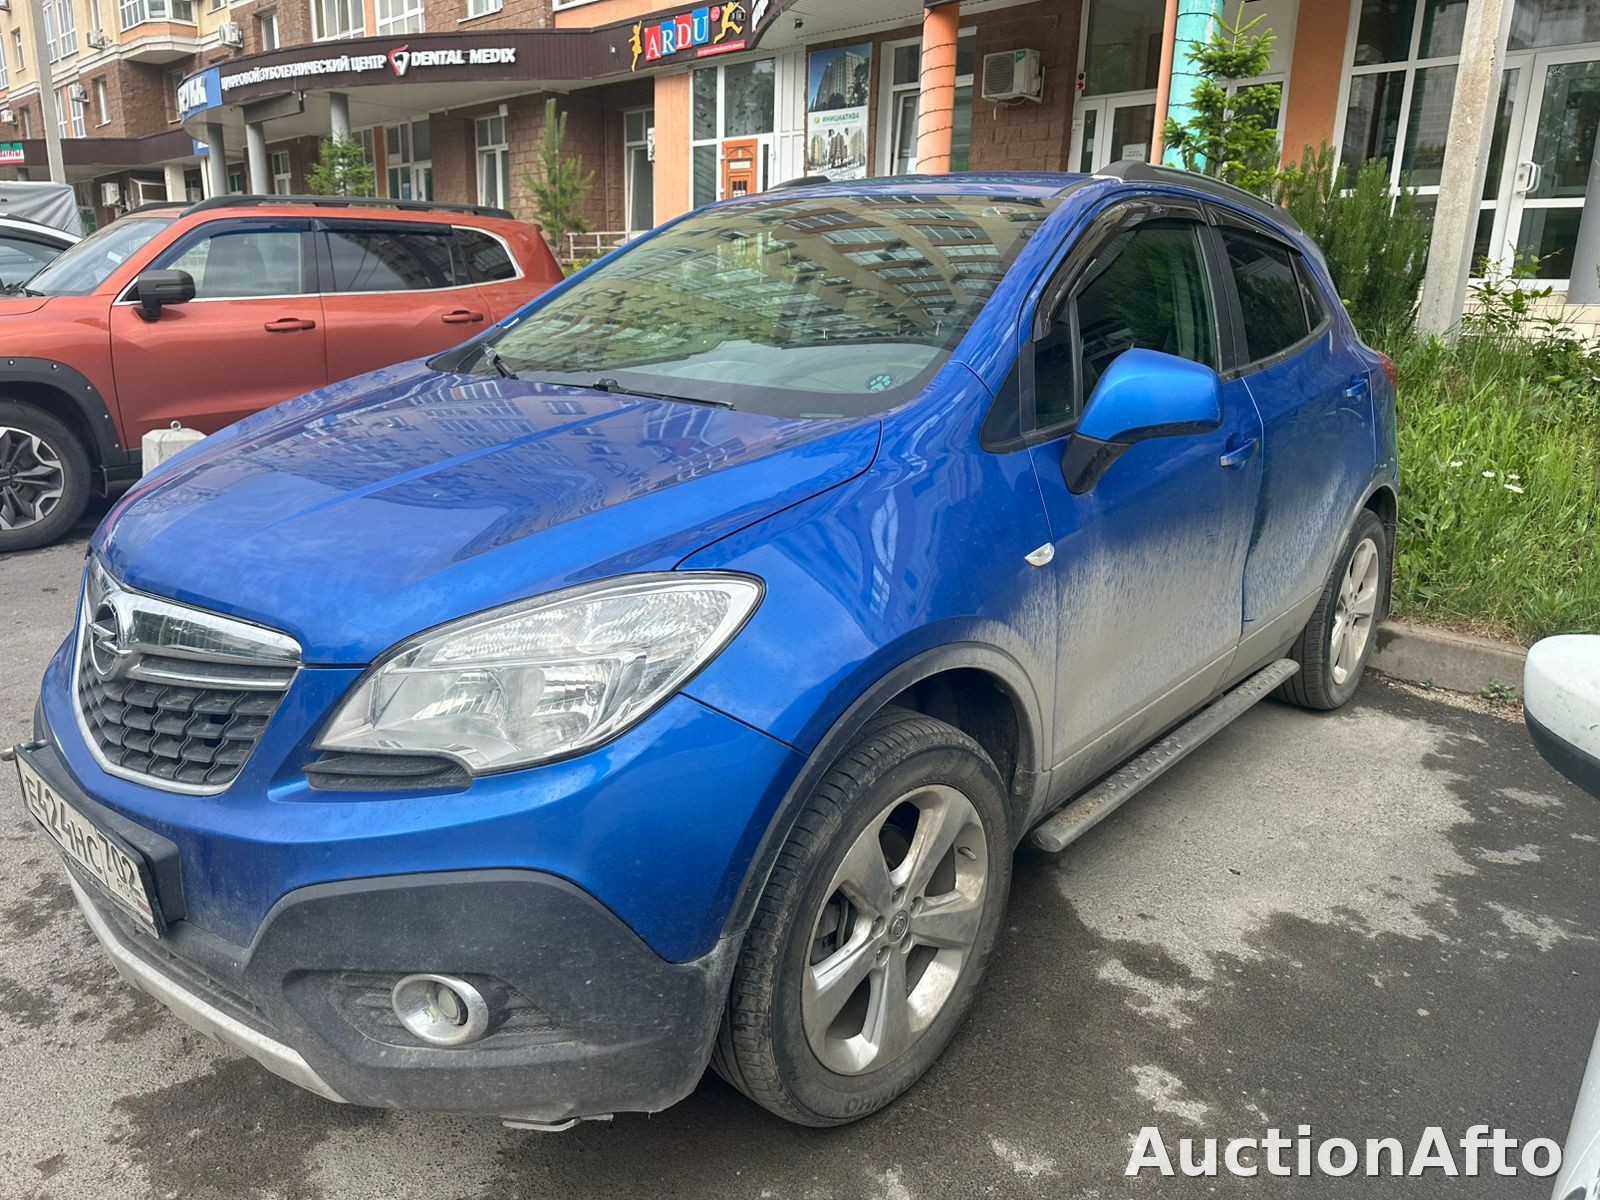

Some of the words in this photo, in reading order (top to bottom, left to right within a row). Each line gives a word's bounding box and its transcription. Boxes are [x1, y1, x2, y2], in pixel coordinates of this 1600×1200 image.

[645, 16, 708, 59] ARDU
[351, 55, 387, 73] ЦЕНТР
[411, 50, 465, 66] DENTAL
[469, 48, 516, 64] MEDIX
[97, 831, 143, 898] 702
